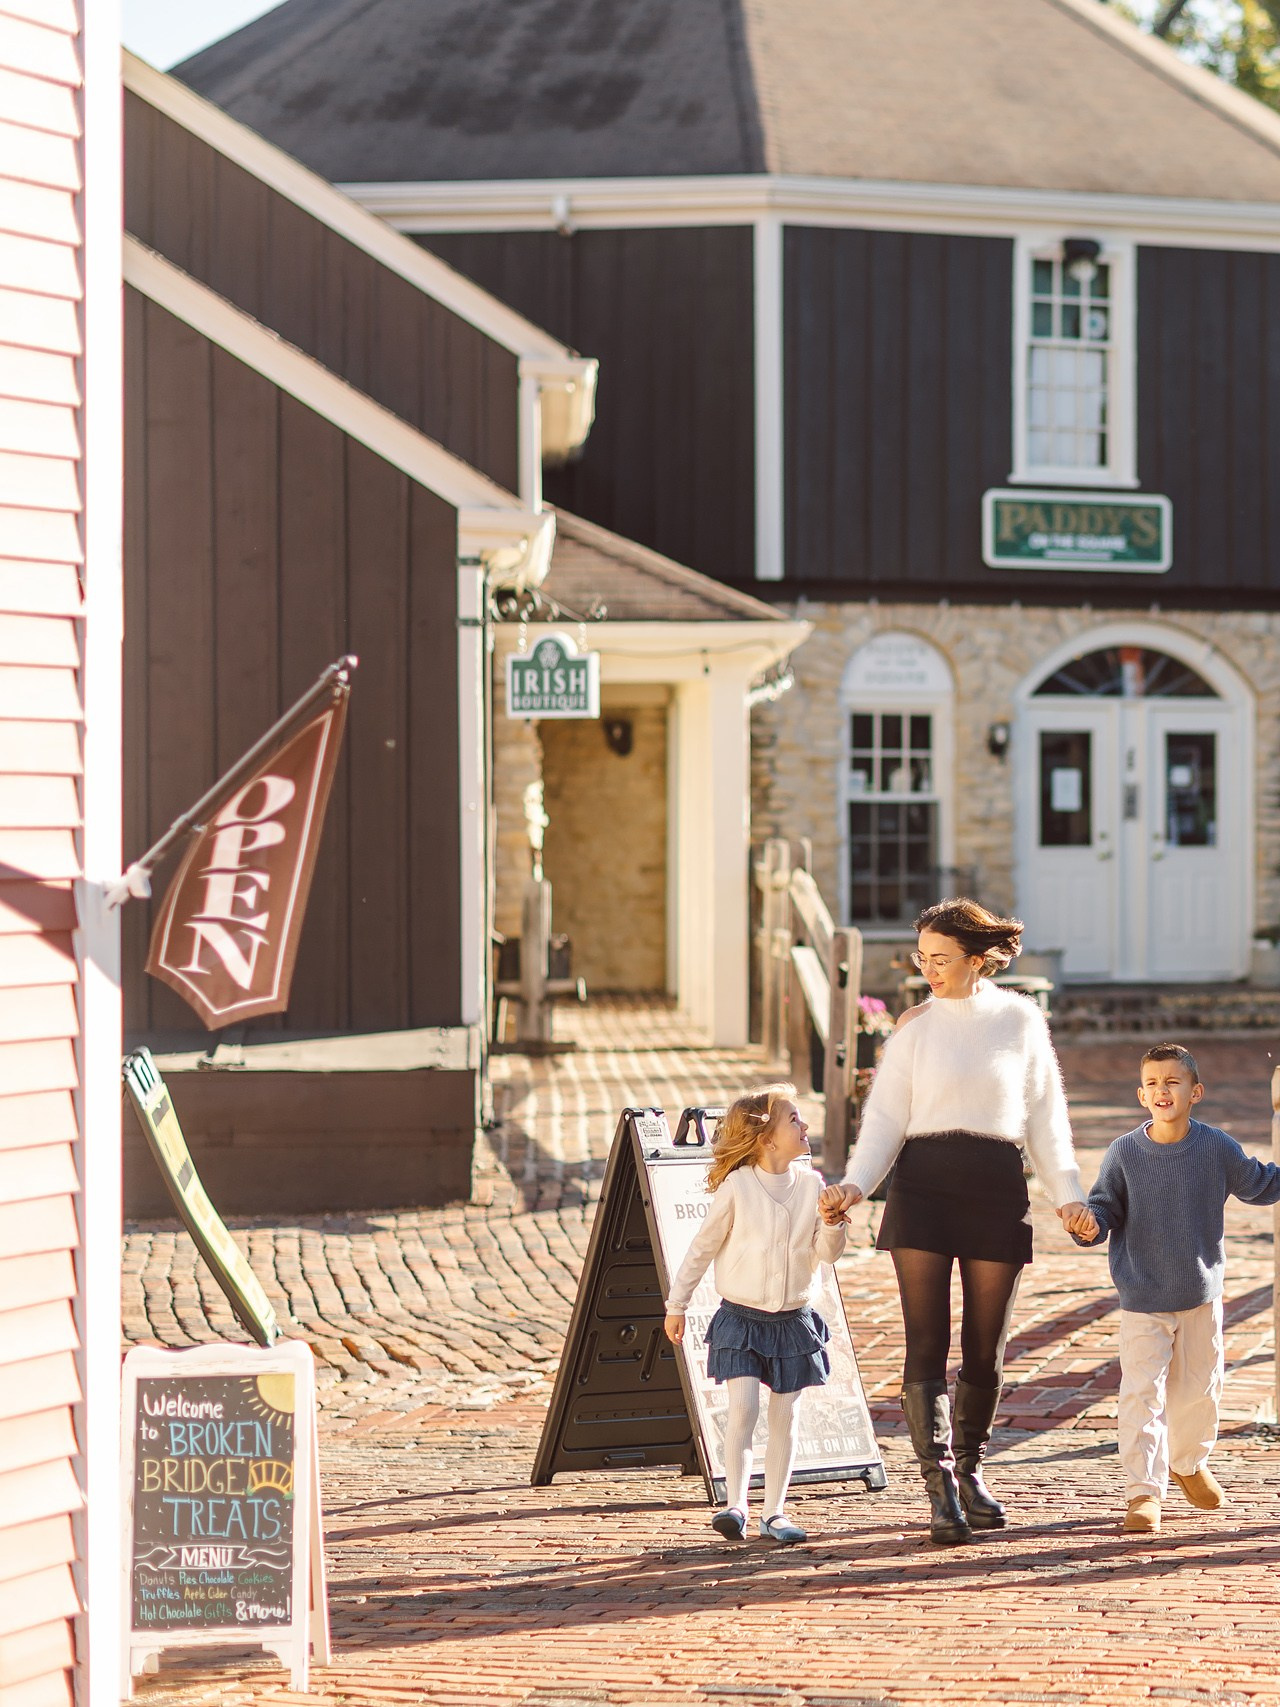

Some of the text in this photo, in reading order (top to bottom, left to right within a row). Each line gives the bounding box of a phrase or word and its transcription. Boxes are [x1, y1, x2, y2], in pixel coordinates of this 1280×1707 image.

[997, 502, 1160, 547] PADDY'S
[513, 668, 586, 694] IRISH
[513, 695, 586, 711] BOUTIQUE
[178, 775, 296, 990] OPEN
[674, 1203, 711, 1220] BRO
[142, 1391, 224, 1419] Welcome
[140, 1420, 273, 1458] to BROKEN
[796, 1436, 861, 1455] OME ON IN!
[141, 1456, 246, 1496] BRIDGE
[162, 1495, 281, 1540] TREATS
[180, 1546, 233, 1568] MENU
[139, 1571, 274, 1586] Donuts Pies Chocolate Cookies
[140, 1585, 258, 1601] Truffles Apple Cider Candy
[140, 1604, 156, 1621] Hot
[158, 1602, 202, 1619] Chocolate
[204, 1602, 233, 1619] Gifts
